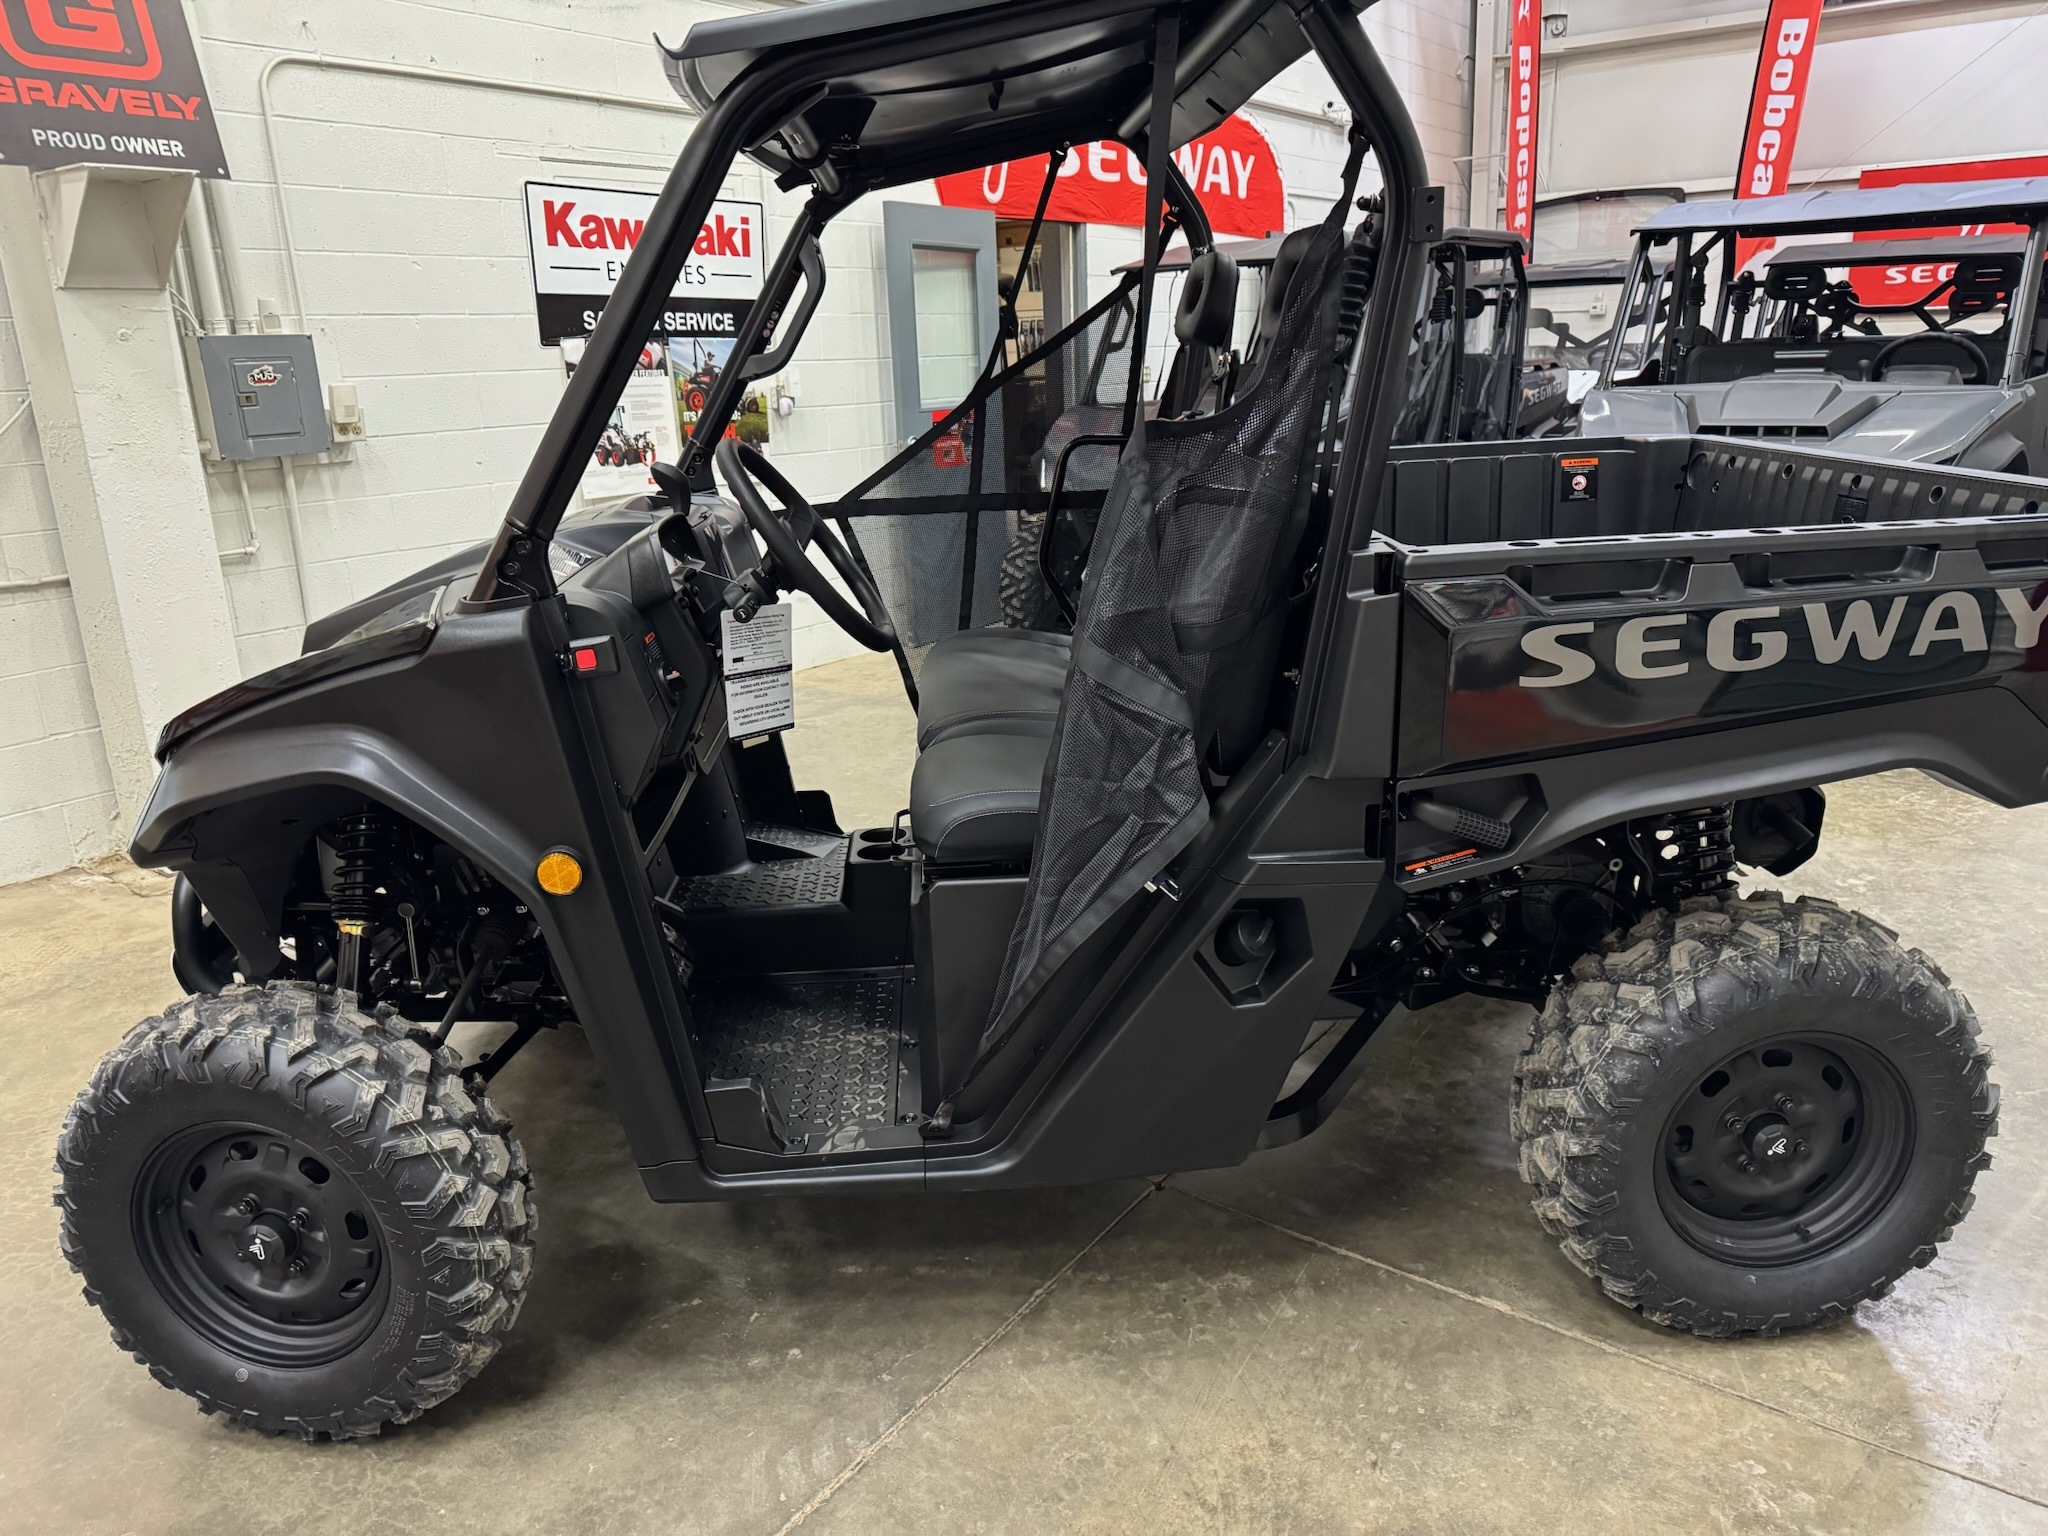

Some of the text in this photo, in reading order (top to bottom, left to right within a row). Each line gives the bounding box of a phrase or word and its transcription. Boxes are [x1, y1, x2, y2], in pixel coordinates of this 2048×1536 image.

[1751, 17, 1810, 196] Bobca
[31, 128, 186, 157] PROUD OWNER
[543, 199, 752, 258] Kawaki
[1884, 263, 1961, 285] SEG
[664, 312, 735, 332] SERVICE
[1518, 587, 2048, 688] SEGWAY
